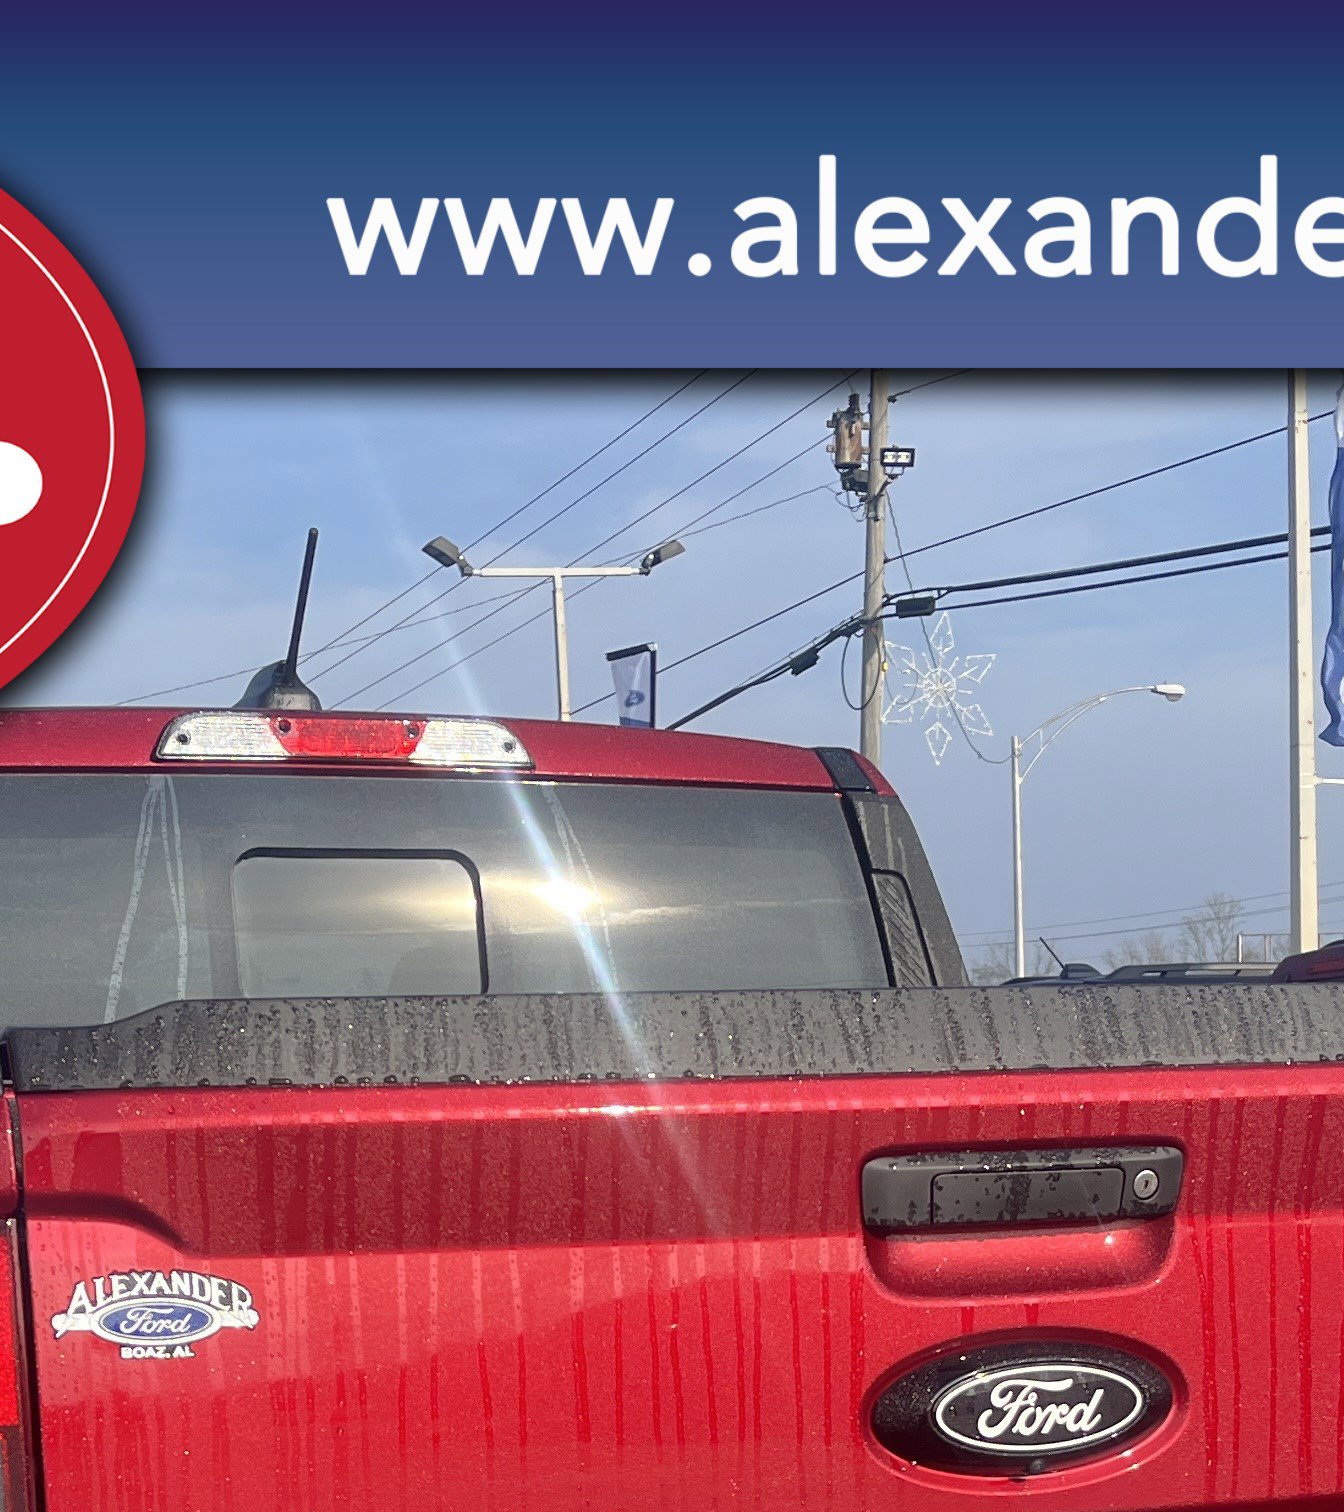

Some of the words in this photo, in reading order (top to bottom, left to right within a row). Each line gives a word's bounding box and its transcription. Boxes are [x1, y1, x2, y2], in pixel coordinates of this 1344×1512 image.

[56, 1270, 254, 1338] ALEXANDER
[120, 1307, 194, 1334] Ford
[120, 1346, 171, 1359] BOAZ,
[172, 1346, 195, 1358] AL
[977, 1378, 1105, 1438] Ford
